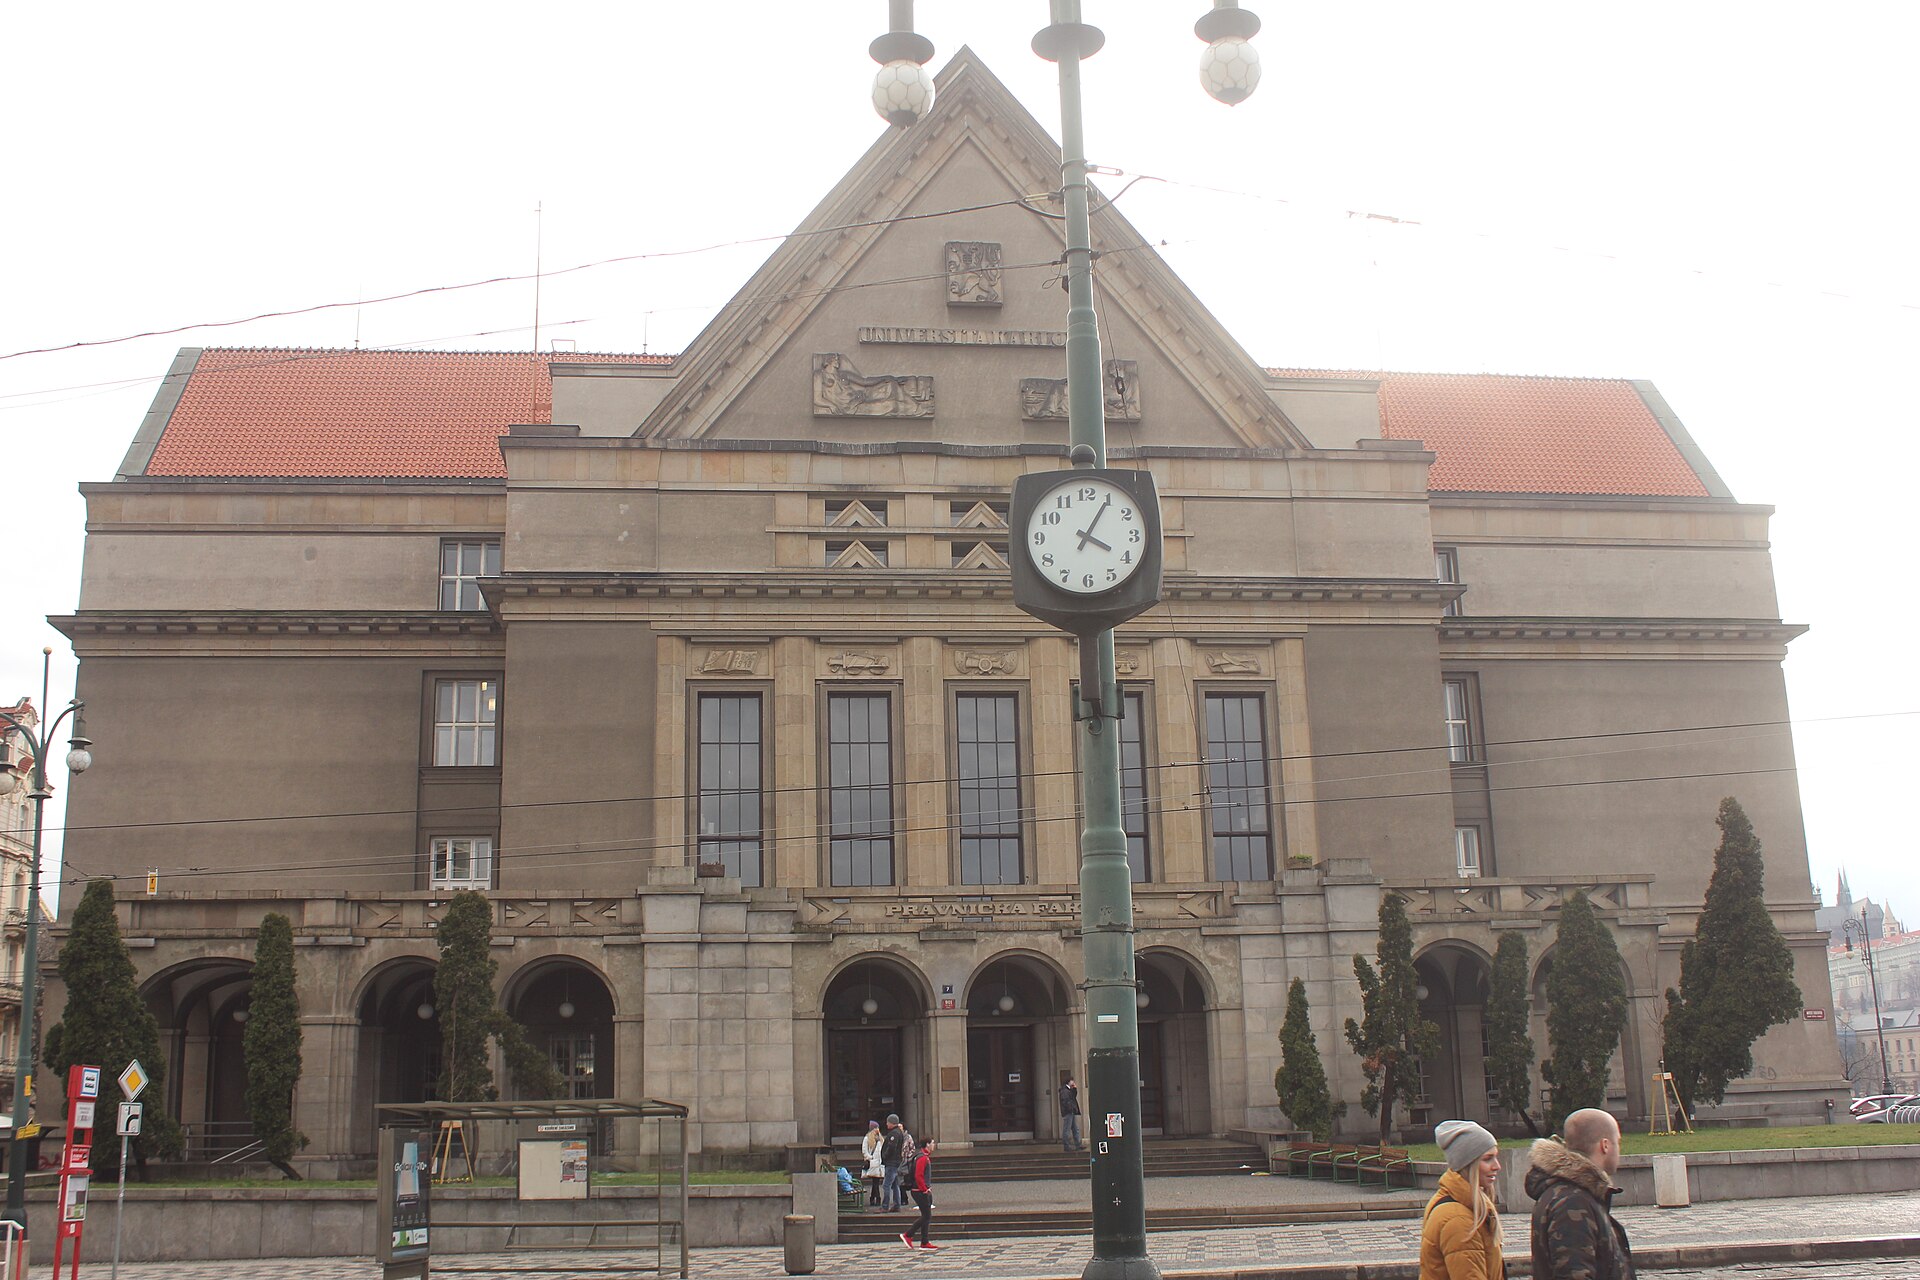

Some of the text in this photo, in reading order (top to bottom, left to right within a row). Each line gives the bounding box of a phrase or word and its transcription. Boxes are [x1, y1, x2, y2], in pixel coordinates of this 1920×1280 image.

[859, 327, 990, 345] UNIVERSITA
[1077, 487, 1096, 501] 12
[1105, 493, 1112, 506] 1
[1056, 495, 1072, 508] 11
[1041, 511, 1061, 525] 10
[1120, 507, 1132, 521] 2
[1034, 532, 1046, 545] 9
[1128, 529, 1140, 543] 3
[1042, 553, 1054, 567] 8
[1120, 550, 1132, 564] 4
[1059, 569, 1070, 583] 7
[1083, 574, 1094, 588] 6
[1106, 568, 1117, 582] 5
[1032, 902, 1144, 915] FAKA
